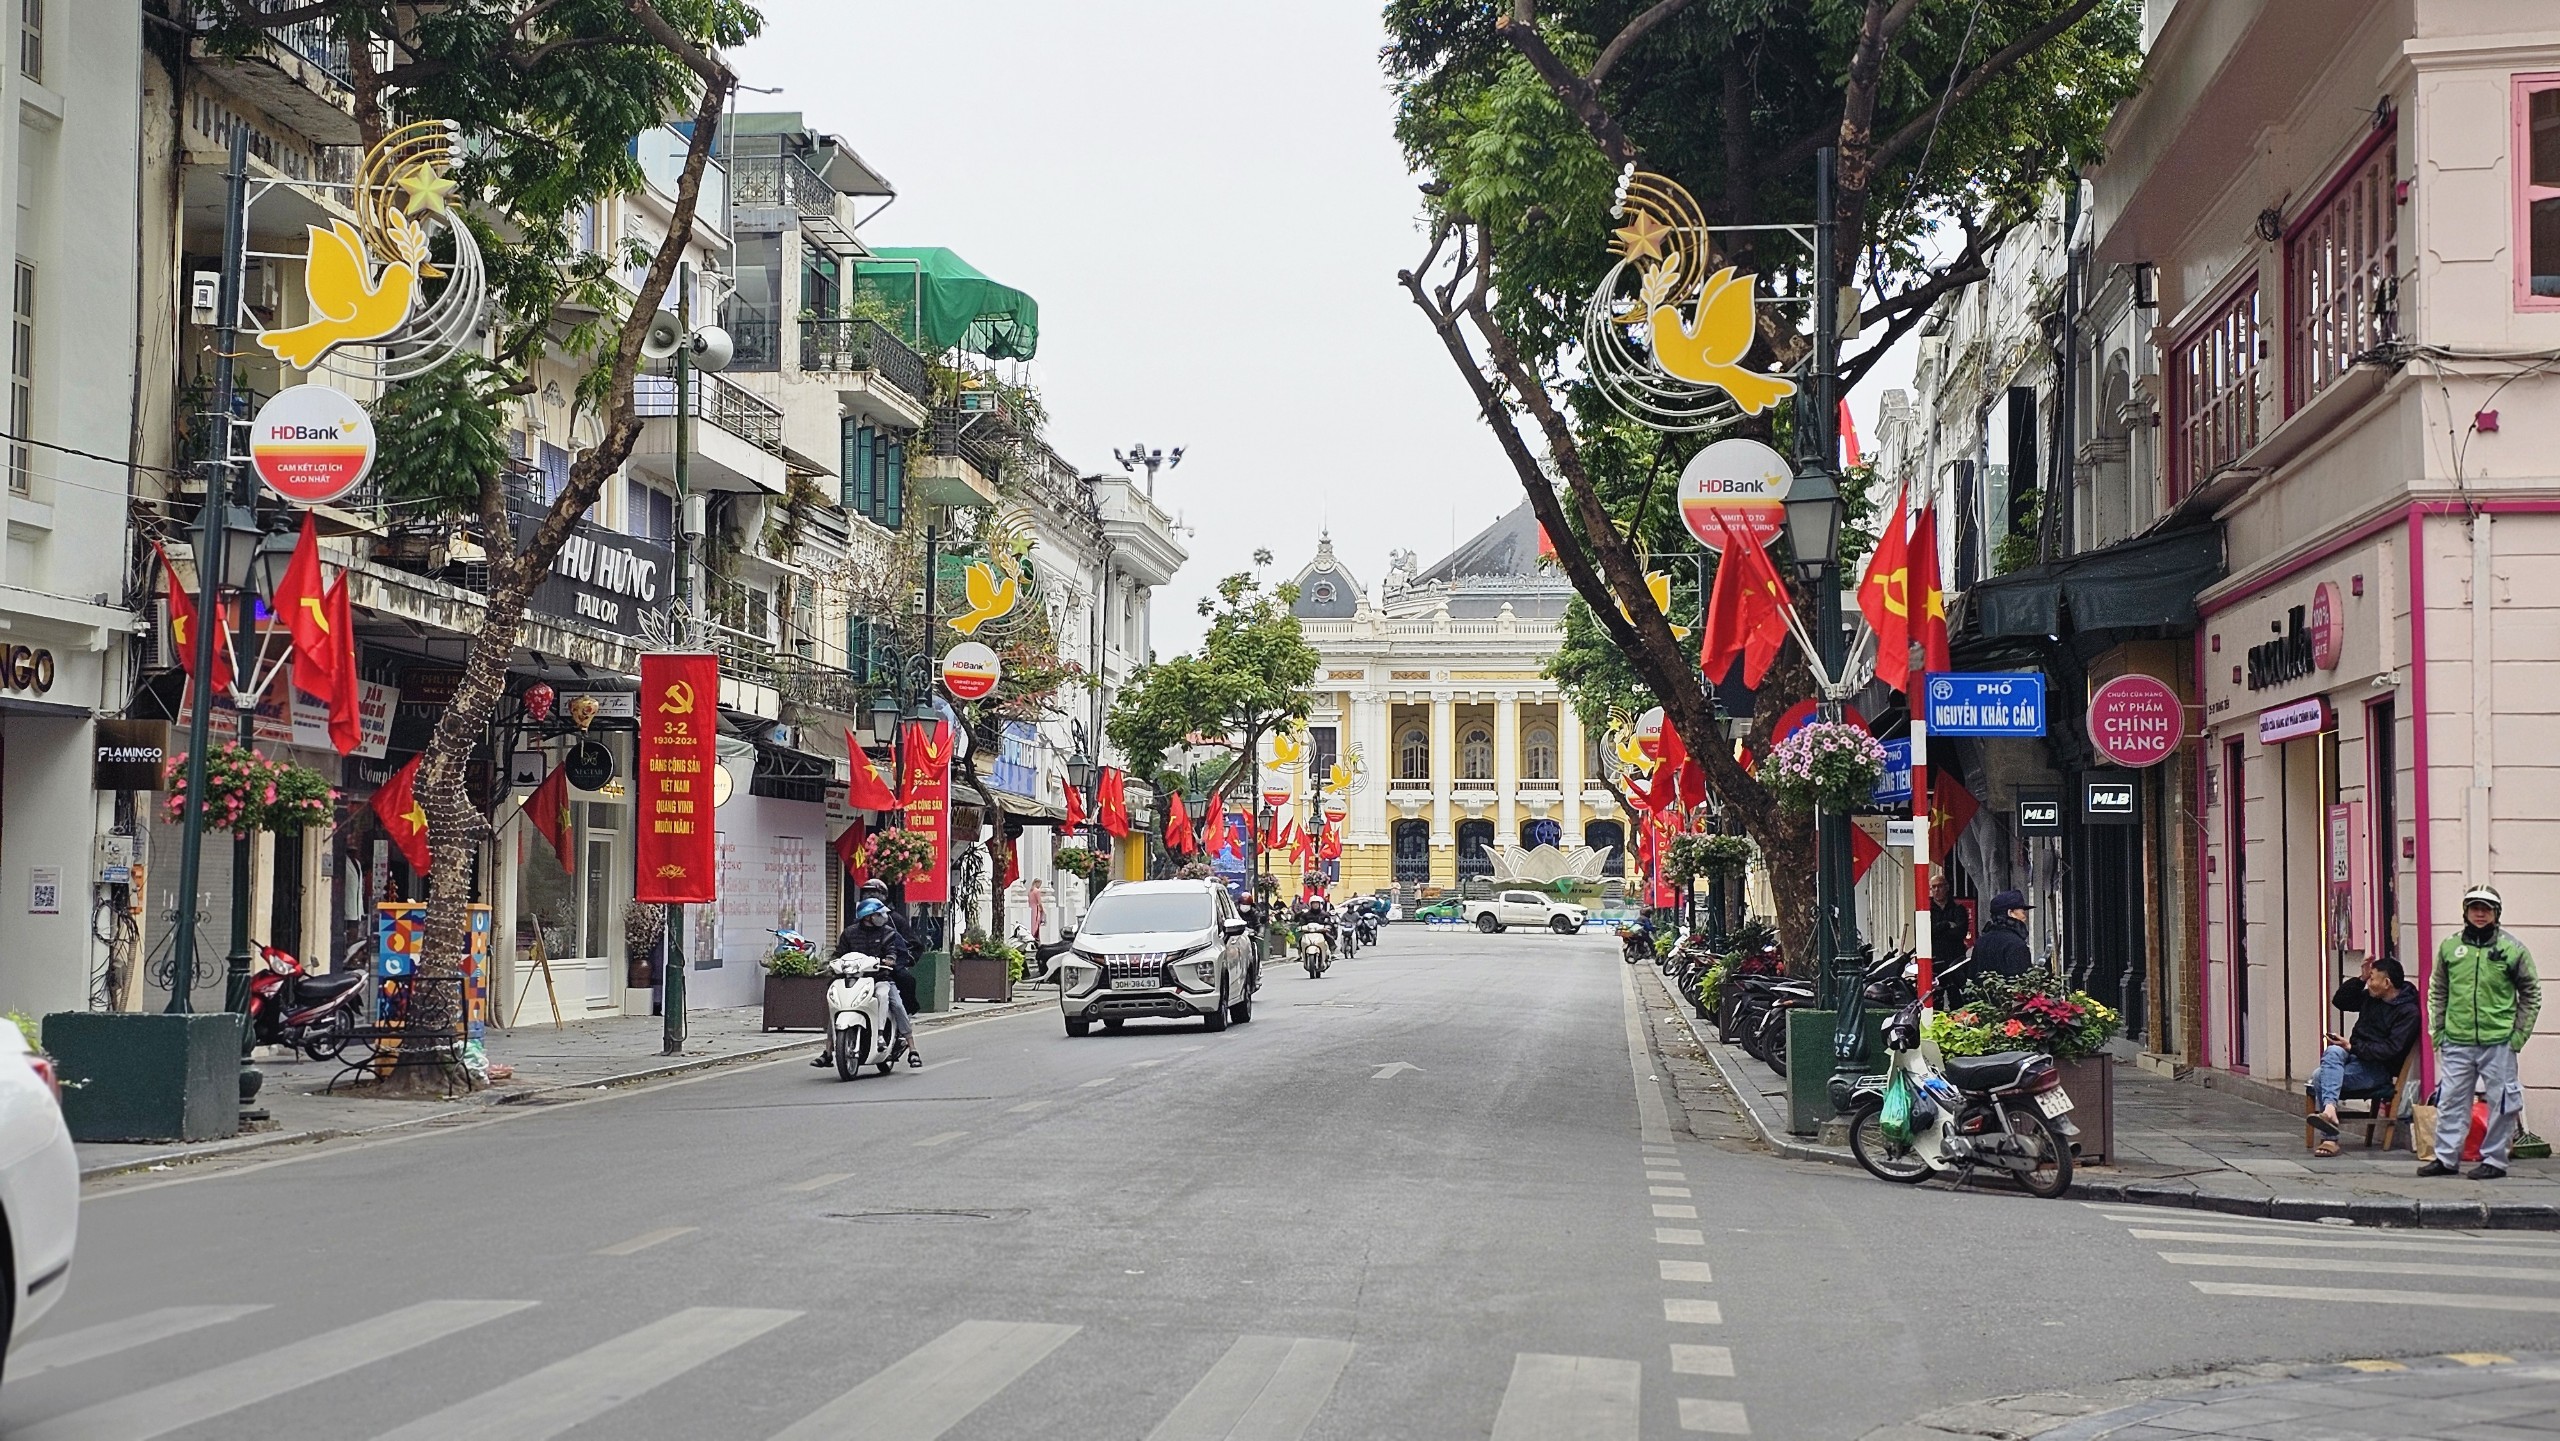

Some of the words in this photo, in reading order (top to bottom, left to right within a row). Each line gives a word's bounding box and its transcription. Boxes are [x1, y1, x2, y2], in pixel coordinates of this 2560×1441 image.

[271, 425, 339, 440] HDBank
[278, 464, 296, 472] CAM
[298, 462, 312, 472] KẾT
[314, 463, 328, 474] LỢI
[328, 462, 343, 472] ÍCH
[289, 475, 307, 484] CAO
[308, 474, 331, 483] NHẤT
[1699, 479, 1764, 493] HDBank
[1756, 514, 1766, 522] TO
[595, 545, 657, 602] HƯNG
[575, 592, 619, 625] TAILOR
[953, 661, 984, 670] HDBank
[1977, 680, 2012, 695] PHỐ
[1936, 698, 1978, 726] NGUYỄN
[1981, 698, 2009, 726] KHẮC
[2109, 701, 2126, 712] MỸ
[664, 721, 688, 735] 3-2
[2104, 714, 2168, 732] CHÍNH
[371, 734, 387, 745] PIN
[653, 736, 698, 745] 1930-2024
[2109, 733, 2165, 750] HÃNG
[98, 746, 163, 762] FLAMINGO
[1888, 744, 1903, 761] PHỐ
[650, 754, 668, 772] ĐẢNG
[668, 757, 686, 775] CỘNG
[687, 755, 701, 773] SẢN
[661, 777, 673, 795] VIỆT
[674, 779, 690, 793] NAM
[2092, 792, 2130, 805] MLB
[656, 800, 677, 814] QUANG
[678, 801, 694, 814] VINH
[2024, 809, 2056, 820] MLB
